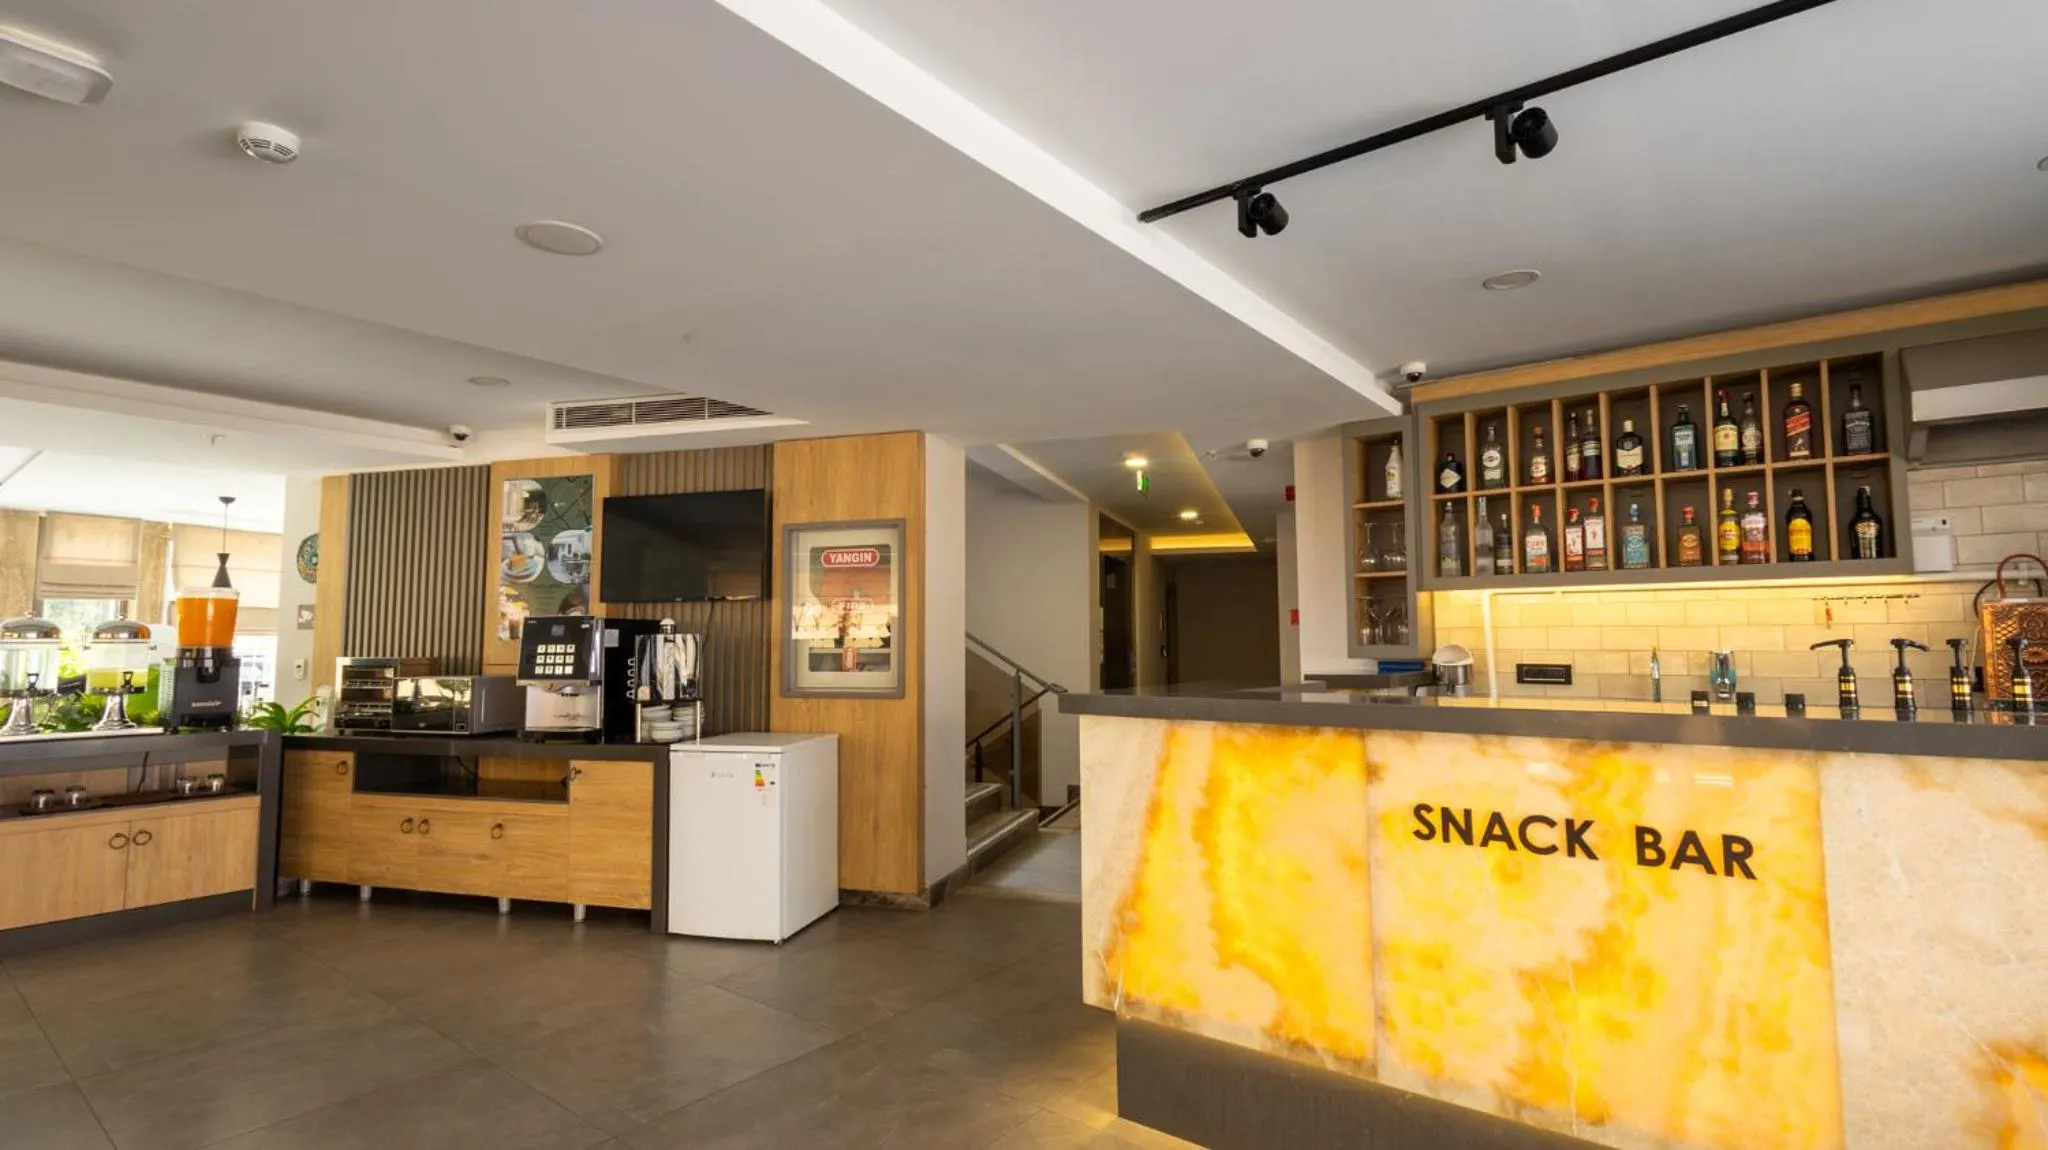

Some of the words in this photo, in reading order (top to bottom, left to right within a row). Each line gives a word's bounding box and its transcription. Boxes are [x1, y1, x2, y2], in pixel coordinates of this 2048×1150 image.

[829, 552, 872, 564] YANGIN
[1412, 803, 1599, 861] SNACK
[1635, 825, 1757, 880] BAR
